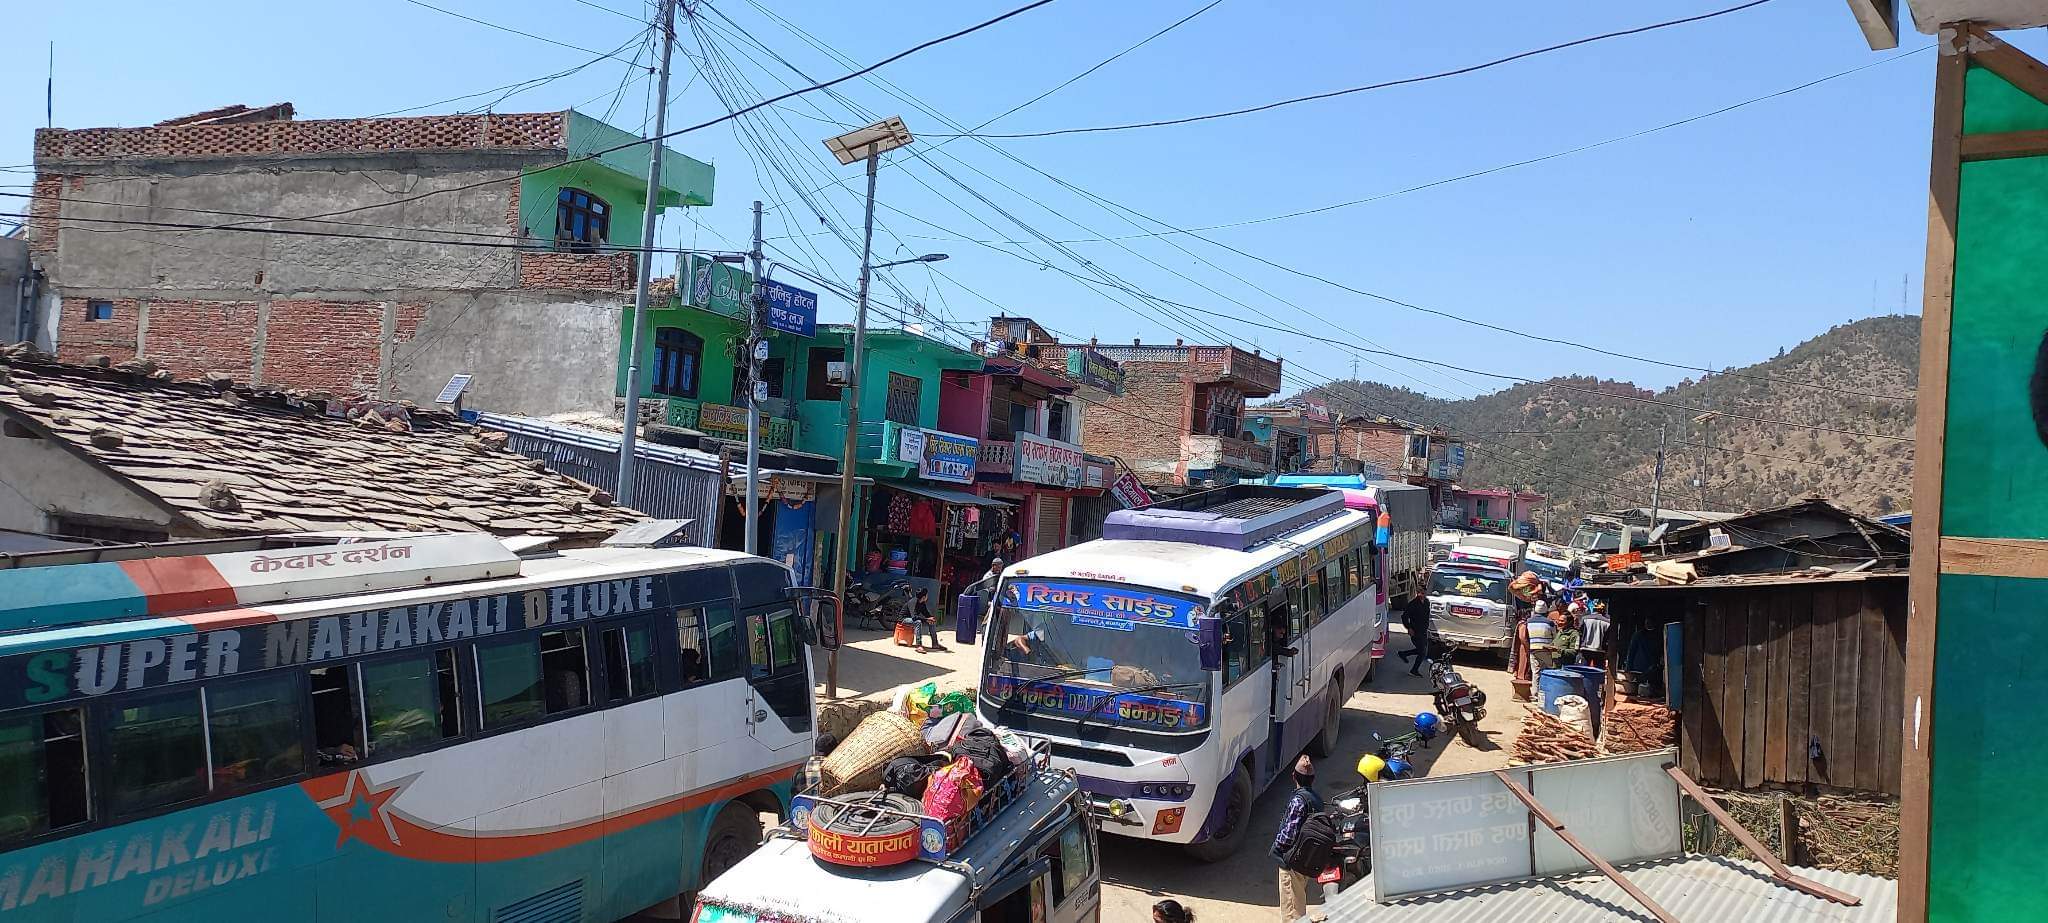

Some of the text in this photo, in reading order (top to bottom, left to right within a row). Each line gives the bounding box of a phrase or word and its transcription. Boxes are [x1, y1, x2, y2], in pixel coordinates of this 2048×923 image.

[793, 291, 815, 310] होटल
[771, 307, 787, 320] एण्ड
[788, 312, 804, 326] लज
[250, 544, 413, 573] केदार दर्शन
[1026, 583, 1178, 618] रिभर साईड
[24, 577, 653, 702] SUPER MAHAKALI DELUXE
[1067, 693, 1116, 715] DELUXE
[809, 822, 844, 852] काली
[847, 834, 913, 855] यातायात
[143, 846, 280, 906] DELUXE
